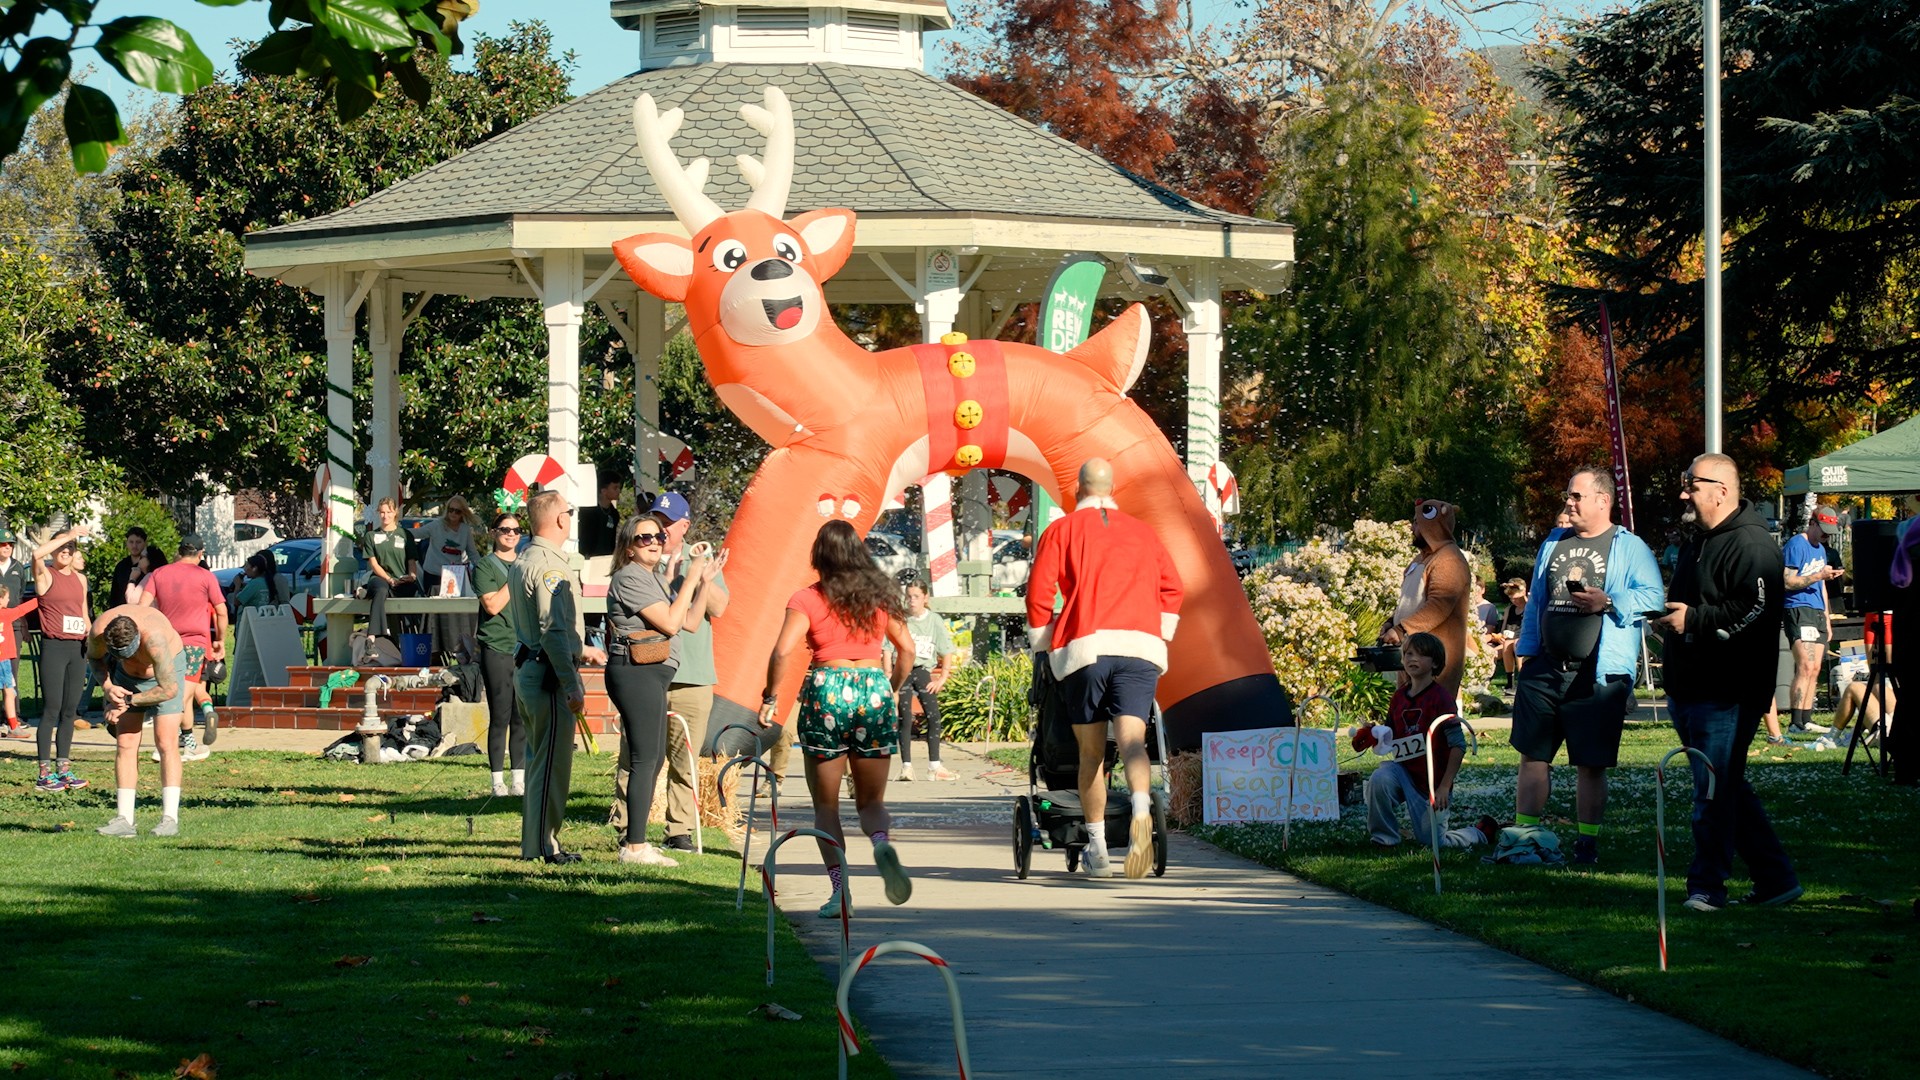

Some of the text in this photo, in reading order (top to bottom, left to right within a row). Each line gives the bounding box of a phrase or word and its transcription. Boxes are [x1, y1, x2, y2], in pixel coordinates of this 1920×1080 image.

[1821, 466, 1848, 476] QUIK
[1821, 475, 1848, 483] SHADE
[660, 496, 671, 509] LA
[1550, 547, 1606, 574] IT'S NOT XMAS
[1728, 577, 1766, 634] carhartt
[66, 619, 85, 632] 103
[1210, 739, 1319, 767] Keep ON
[1392, 738, 1425, 759] 212
[1216, 772, 1332, 804] Leapng
